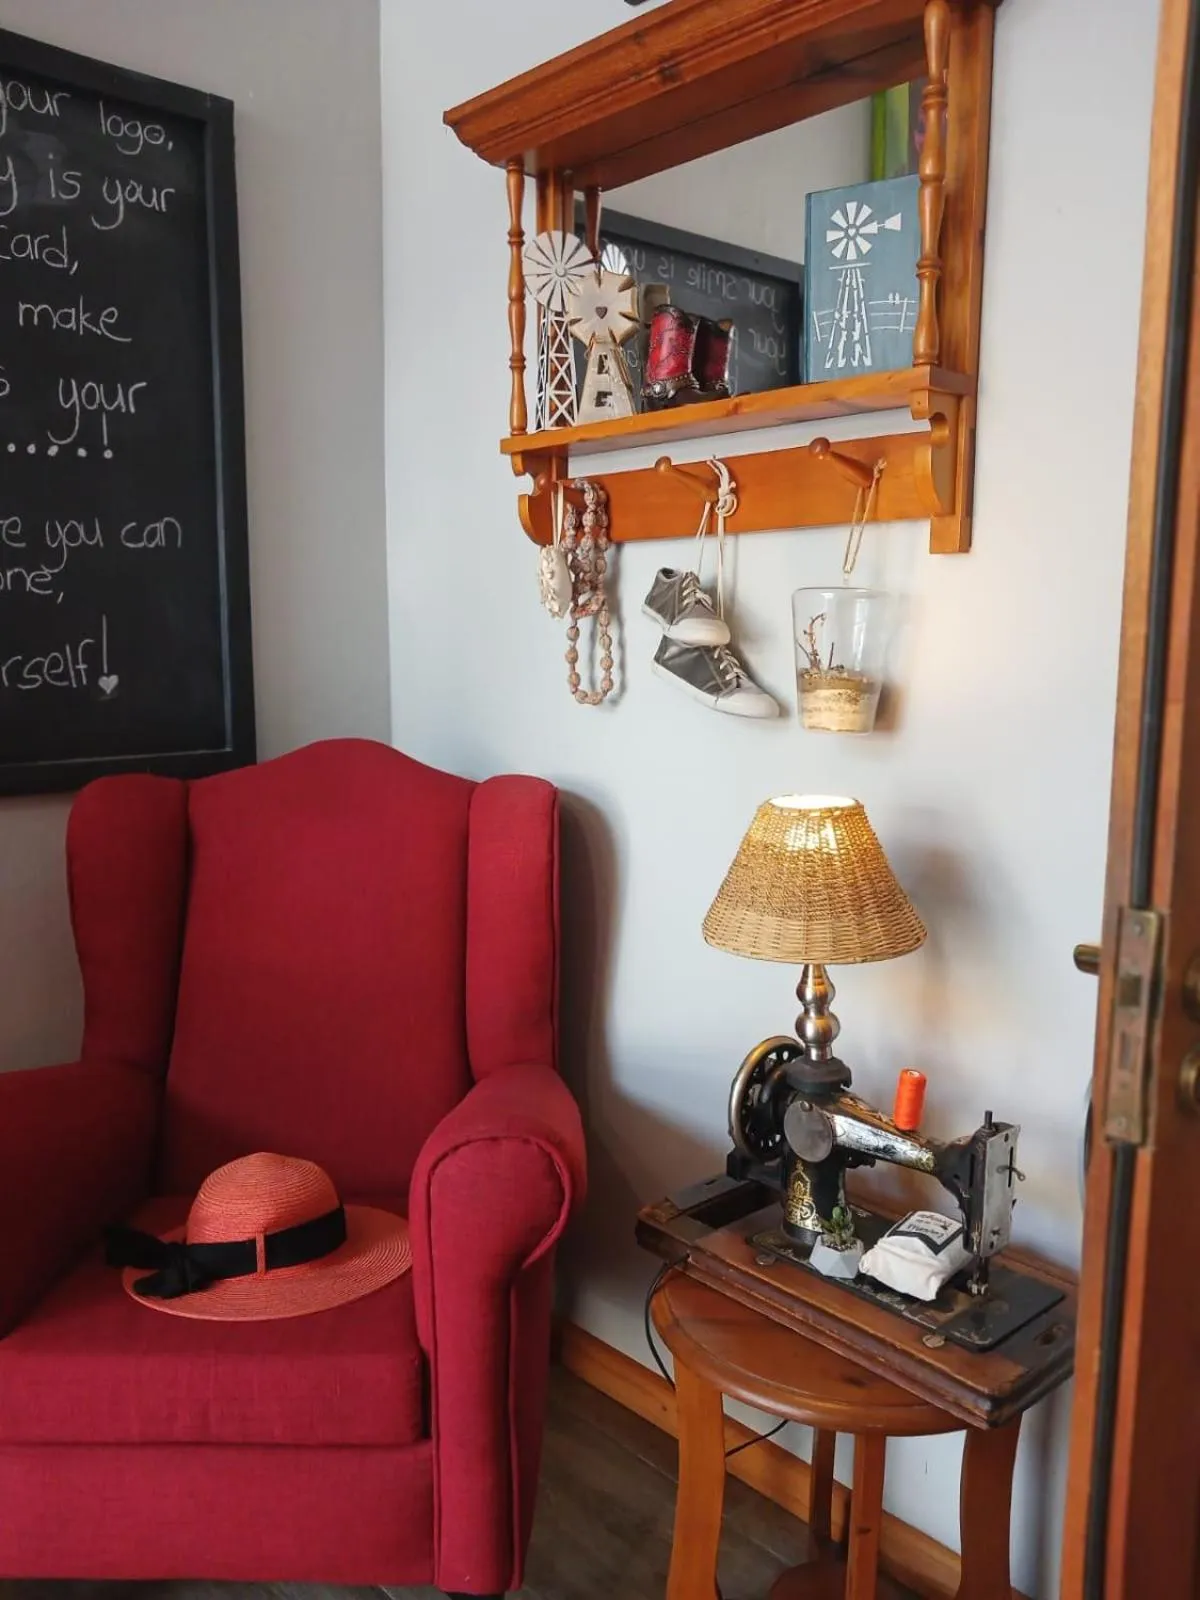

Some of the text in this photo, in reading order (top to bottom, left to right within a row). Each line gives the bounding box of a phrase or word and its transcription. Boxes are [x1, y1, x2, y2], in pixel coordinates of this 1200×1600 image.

[99, 102, 173, 155] logo,
[48, 153, 82, 200] is
[92, 176, 175, 230] your
[18, 294, 132, 342] make
[47, 377, 147, 445] your
[41, 517, 104, 572] you
[120, 517, 182, 548] can
